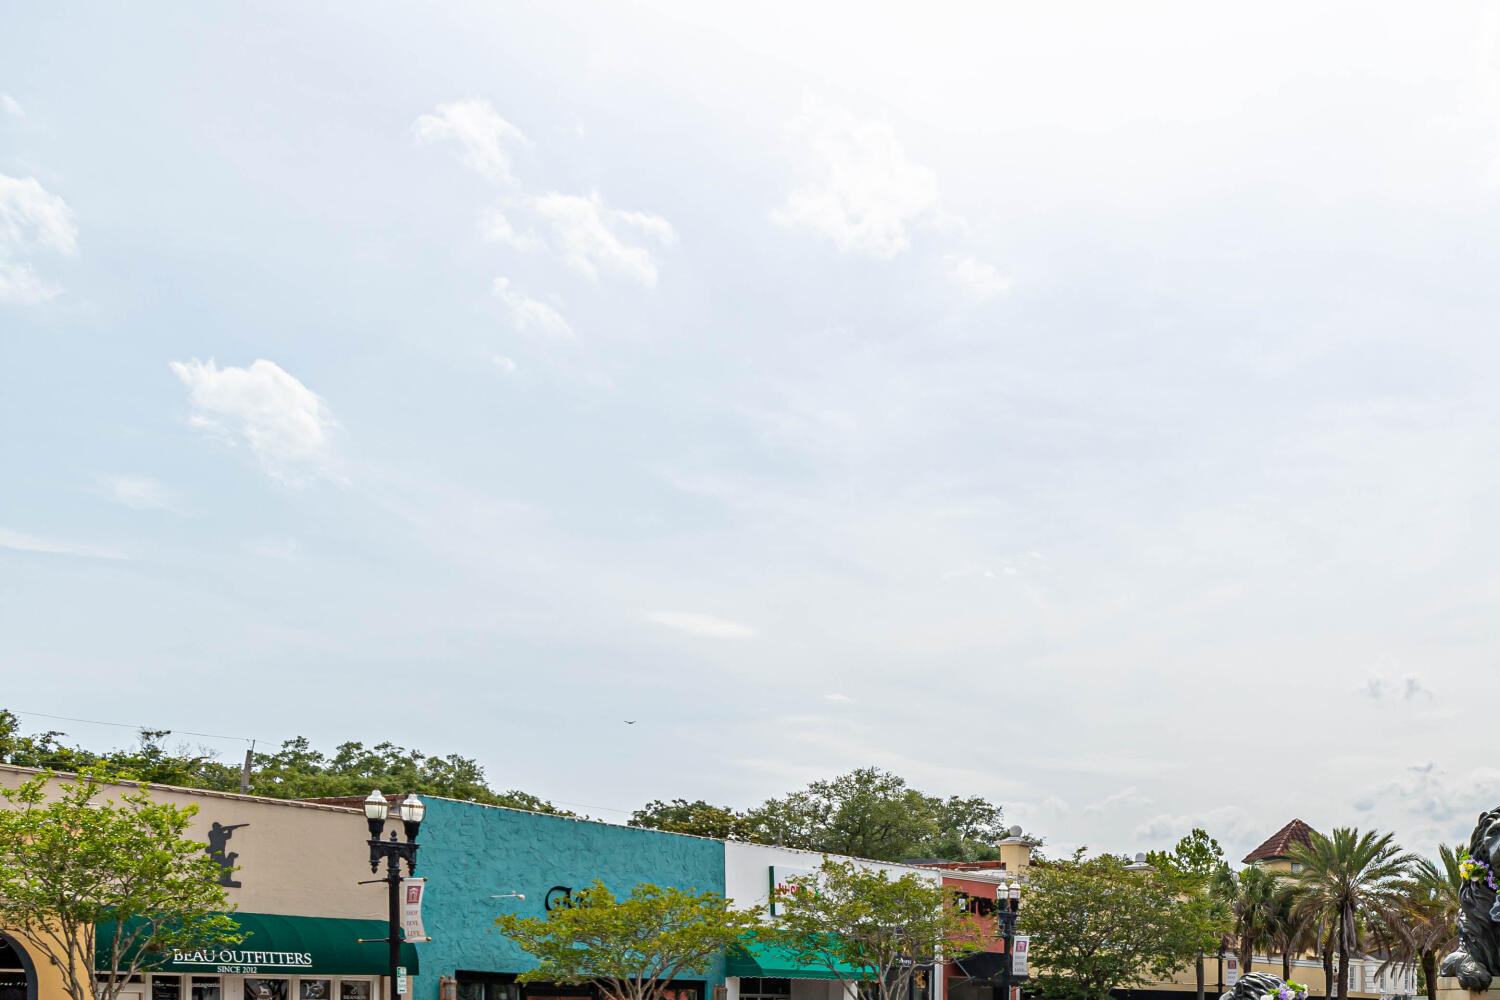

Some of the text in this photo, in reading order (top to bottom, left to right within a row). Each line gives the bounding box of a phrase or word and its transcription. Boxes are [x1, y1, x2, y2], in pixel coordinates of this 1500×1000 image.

[172, 949, 313, 965] BEAU OUTFITTERS
[242, 966, 258, 974] 2012
